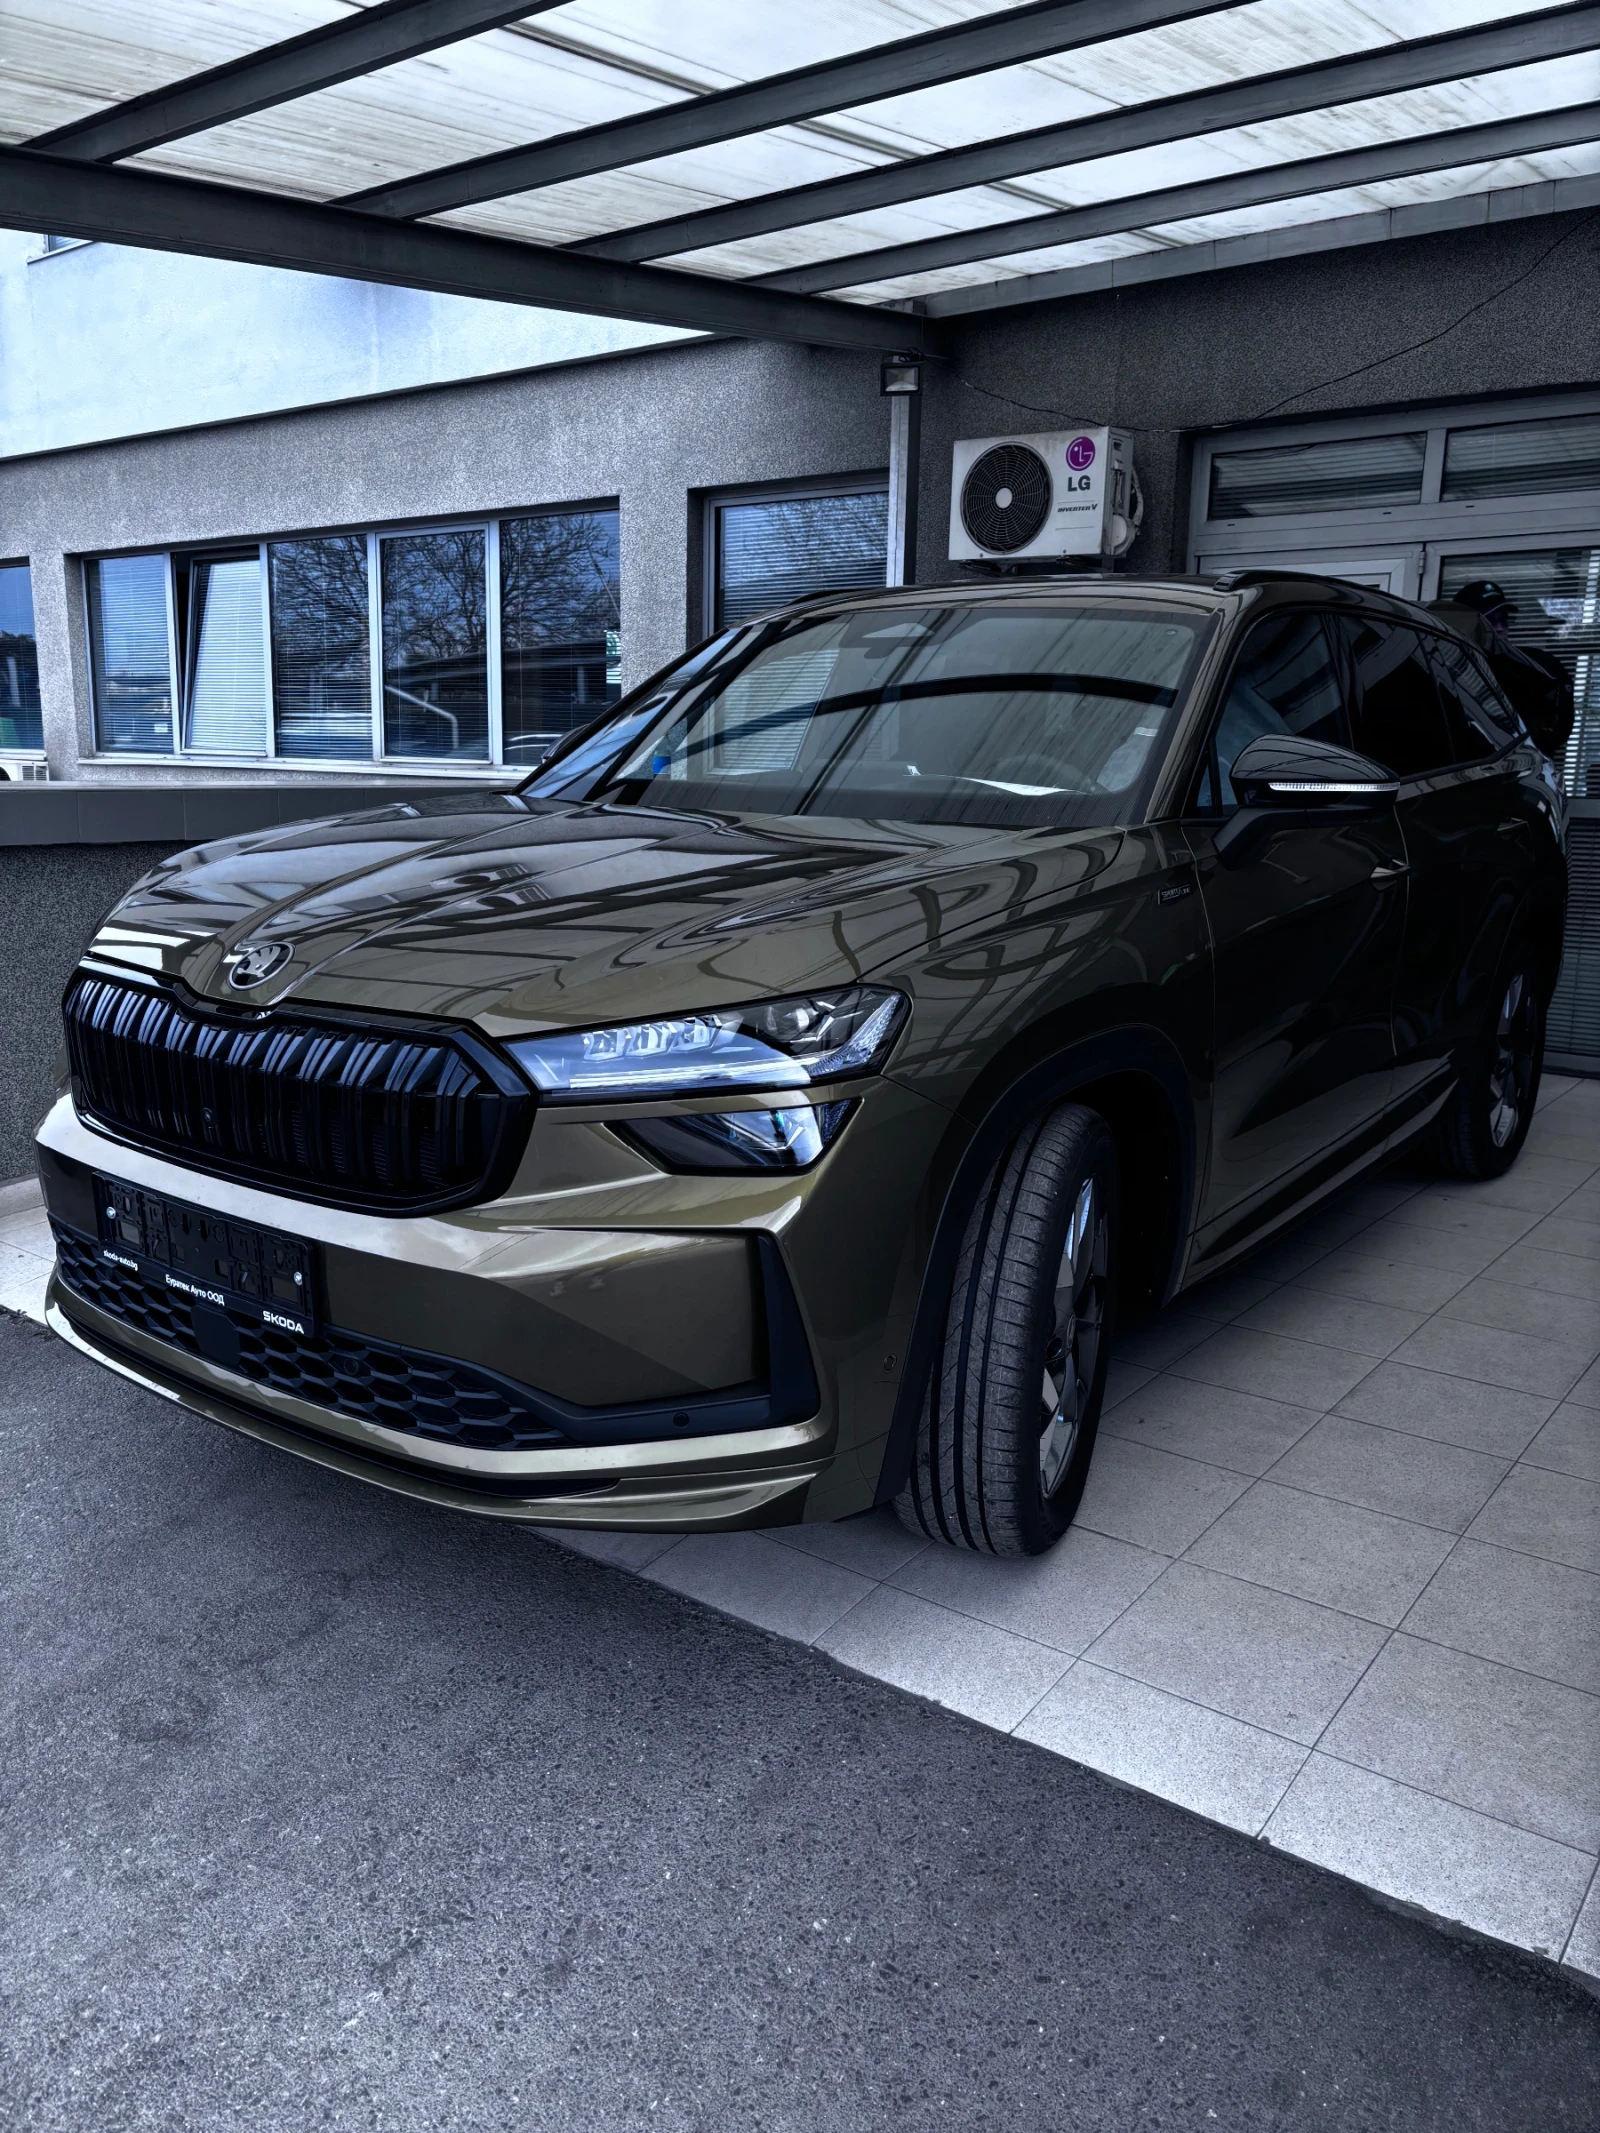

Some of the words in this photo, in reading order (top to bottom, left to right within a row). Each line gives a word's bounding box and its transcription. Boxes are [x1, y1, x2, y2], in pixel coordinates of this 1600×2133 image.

[1067, 475, 1091, 492] LG
[190, 1285, 206, 1298] Ауто
[207, 1290, 225, 1306] ООД
[262, 1310, 305, 1335] SKODA
